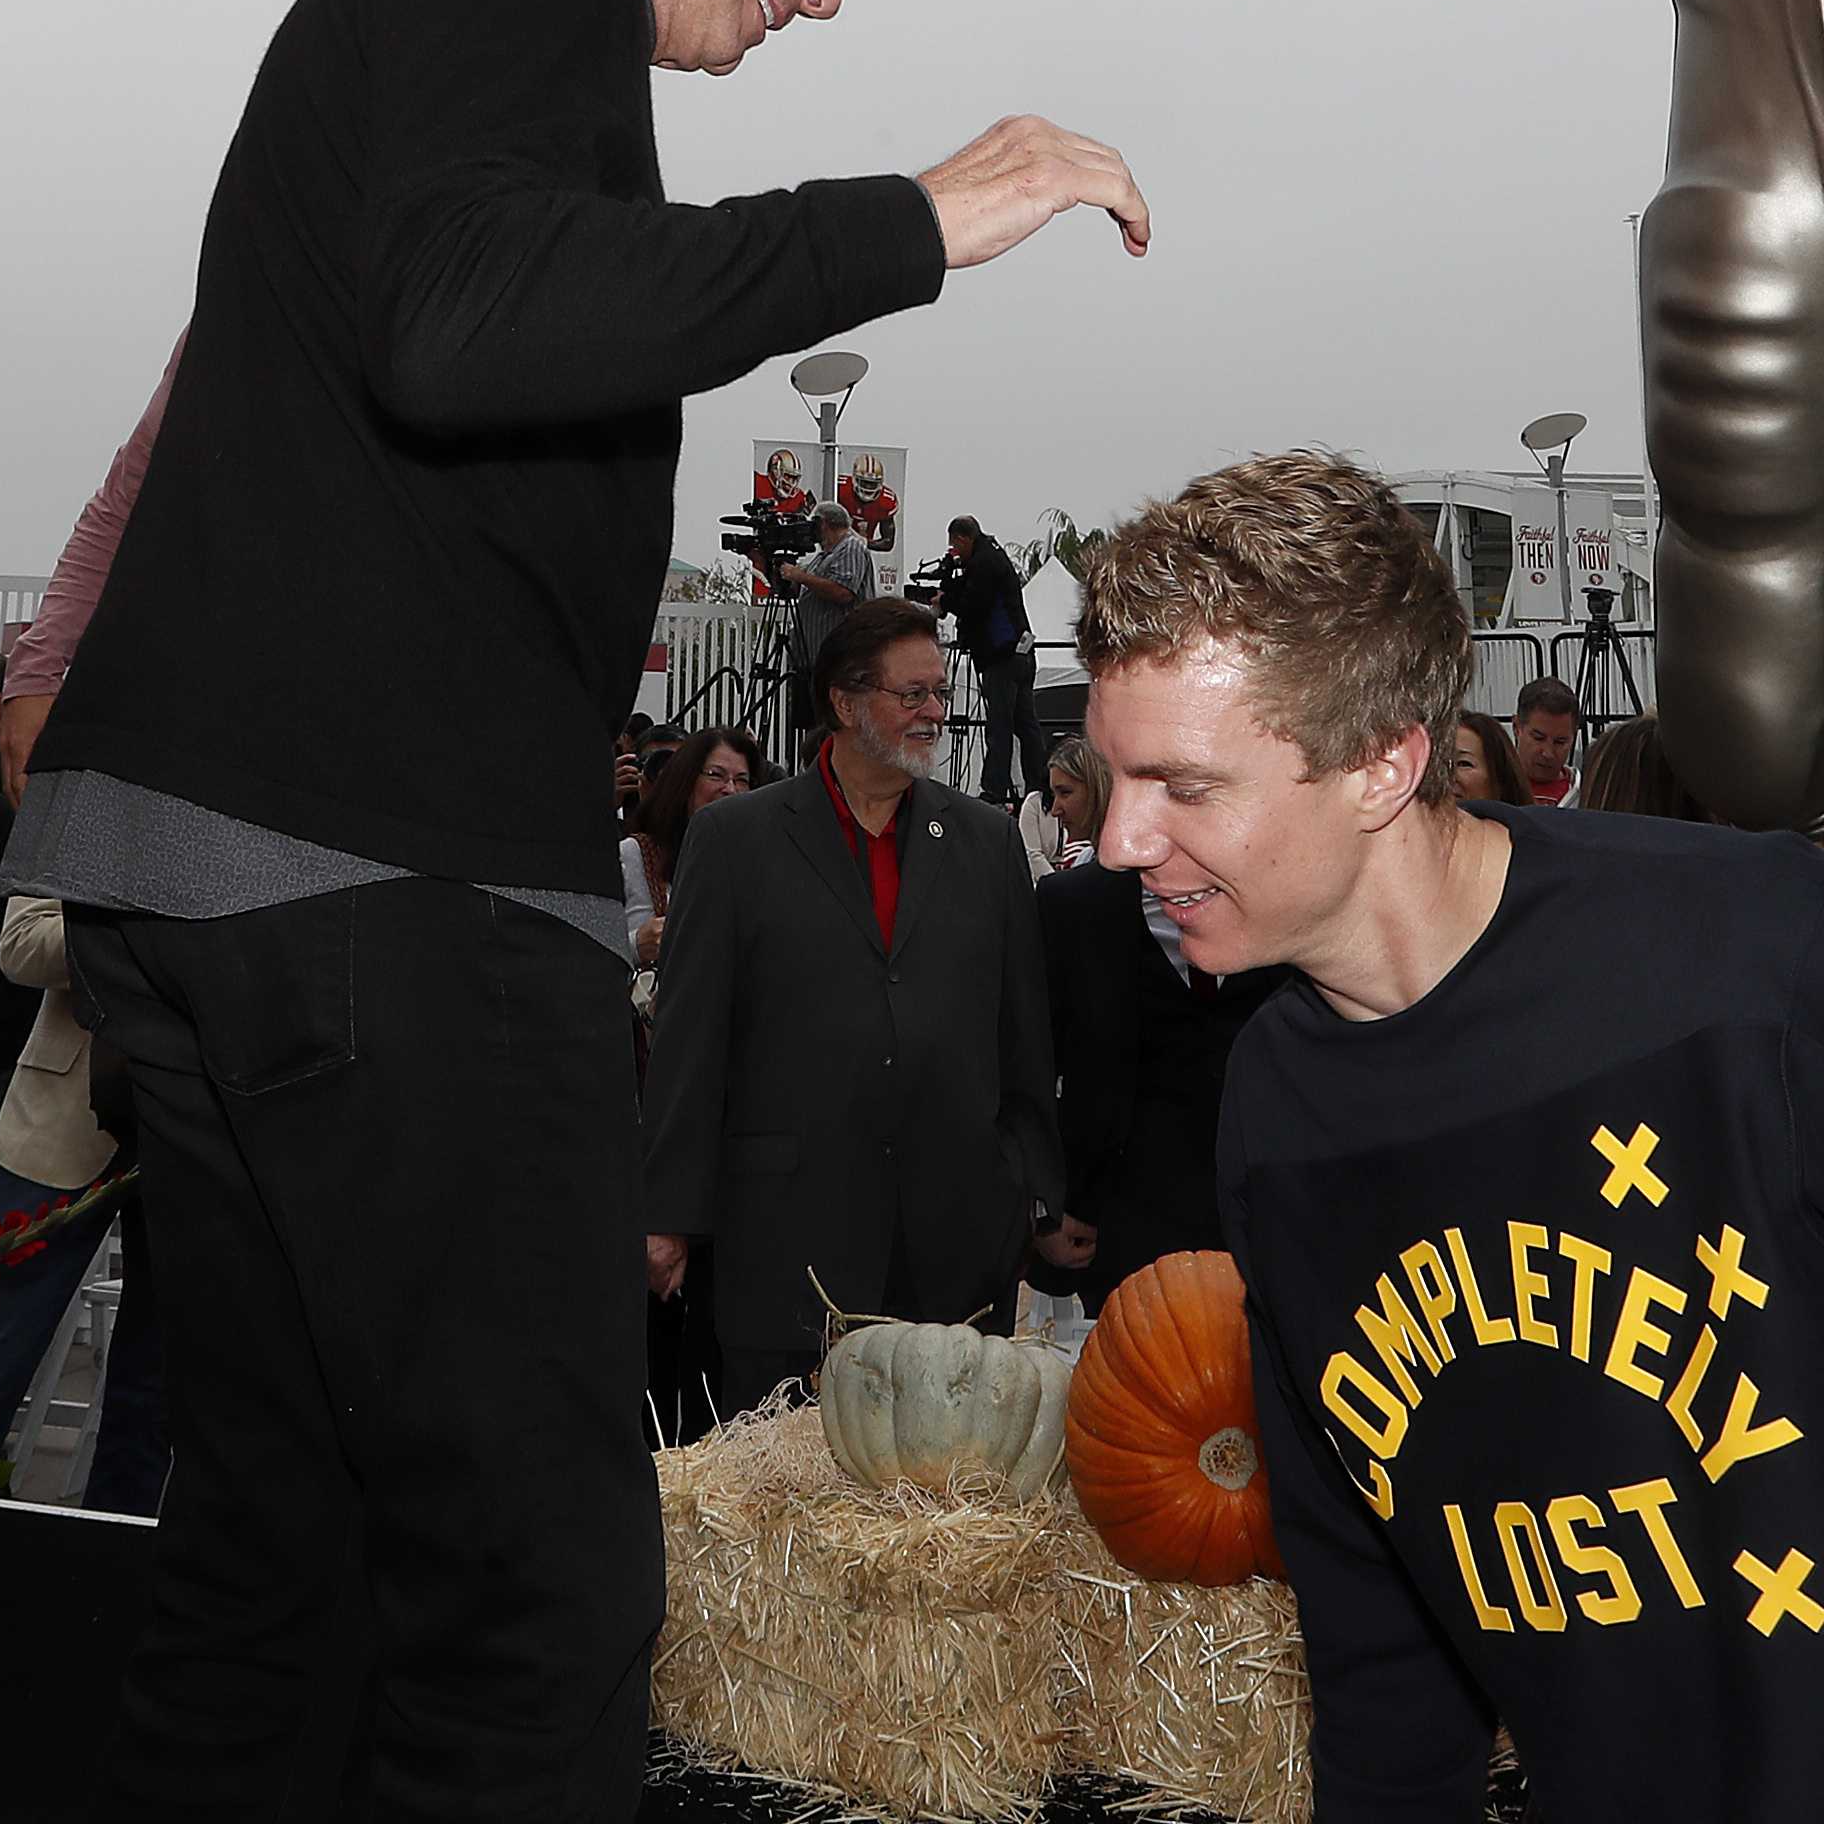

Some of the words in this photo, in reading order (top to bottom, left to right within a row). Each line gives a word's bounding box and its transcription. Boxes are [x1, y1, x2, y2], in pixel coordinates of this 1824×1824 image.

[1518, 542, 1554, 569] THEN
[1578, 544, 1610, 570] NOW
[1443, 1478, 1705, 1633] LOST
